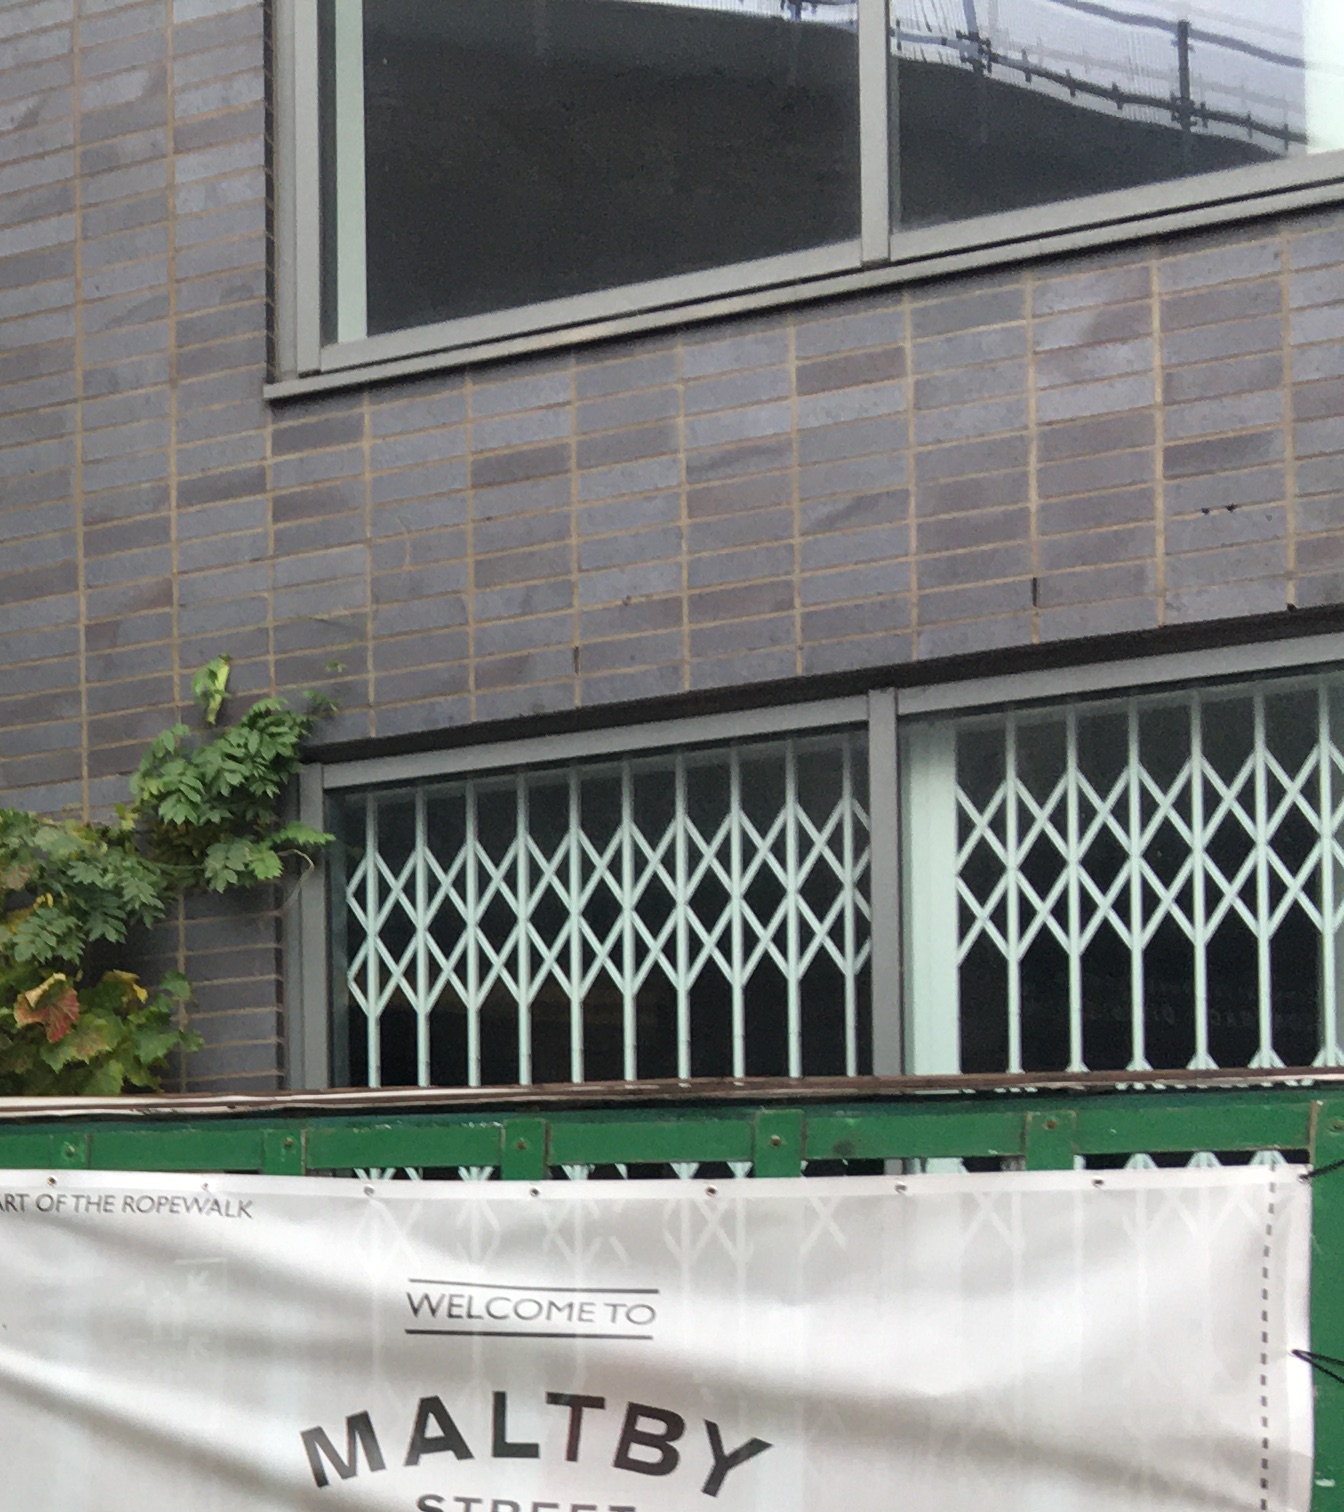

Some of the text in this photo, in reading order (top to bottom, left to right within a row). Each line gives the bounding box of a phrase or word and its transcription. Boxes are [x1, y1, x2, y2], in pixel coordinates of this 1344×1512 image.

[35, 1193, 68, 1213] OF
[70, 1194, 116, 1214] THE
[121, 1195, 254, 1220] ROPEWALK
[406, 1291, 657, 1326] WELCOME TO
[299, 1389, 774, 1500] MALTBY
